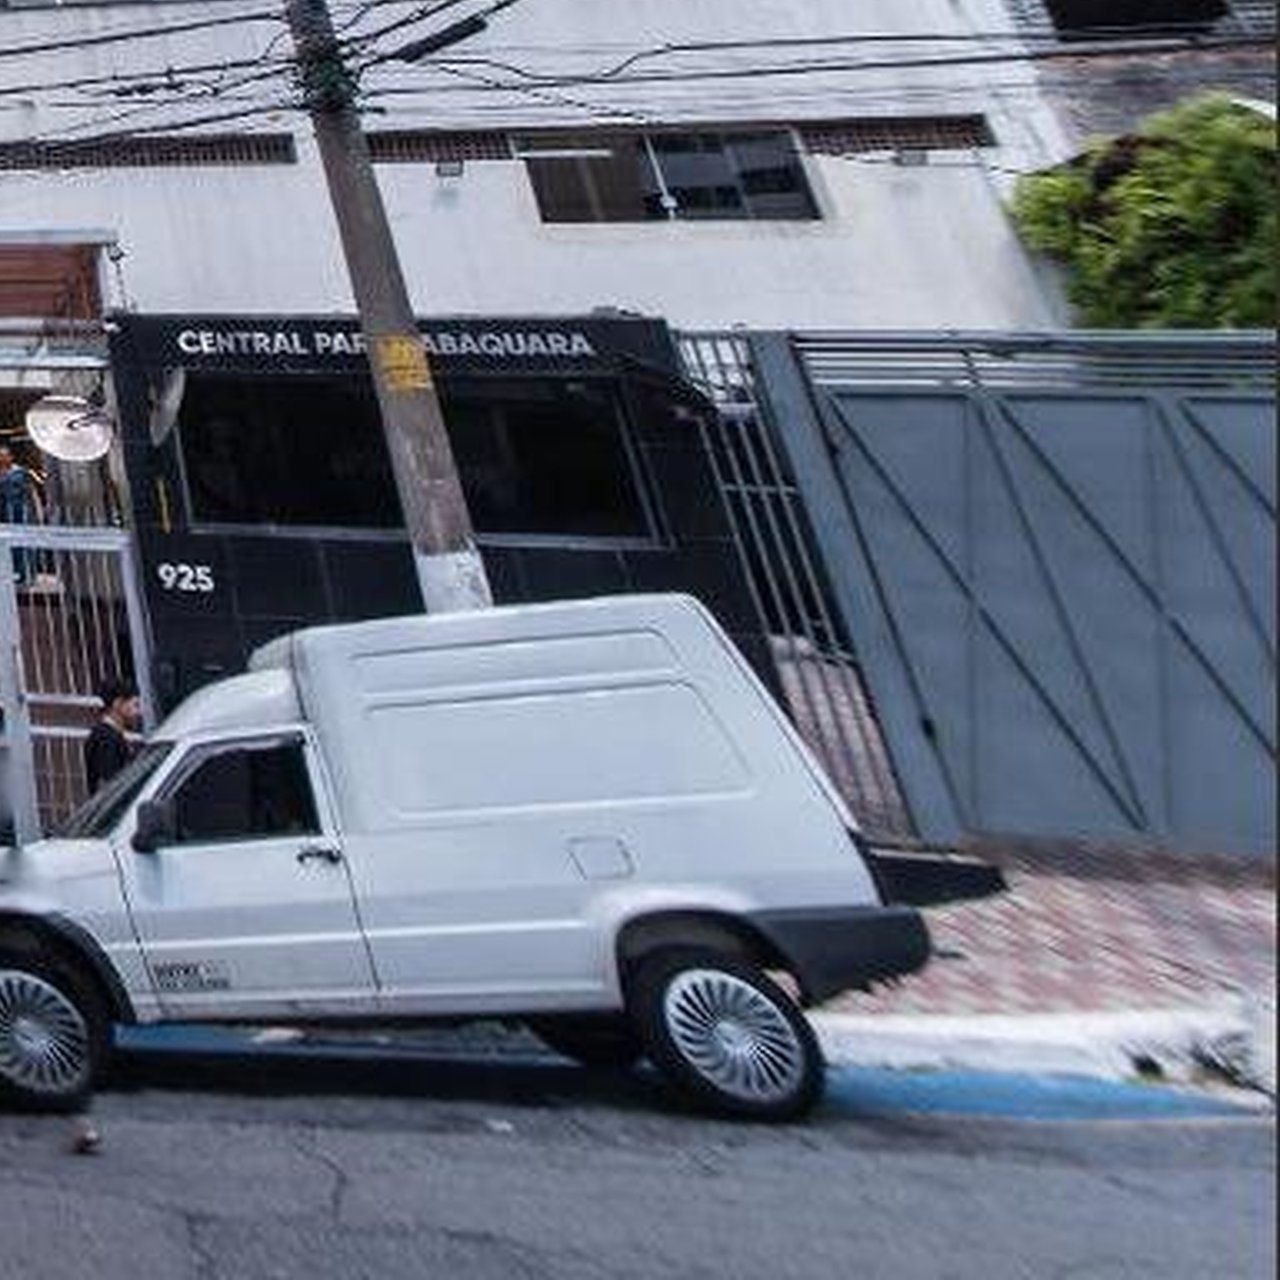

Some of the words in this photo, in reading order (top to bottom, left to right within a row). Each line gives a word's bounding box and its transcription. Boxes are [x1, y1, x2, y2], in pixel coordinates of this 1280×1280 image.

[177, 330, 309, 354] CENTRAL
[313, 331, 368, 355] PAR
[420, 332, 594, 357] ABAQUARA
[157, 562, 215, 592] 925
